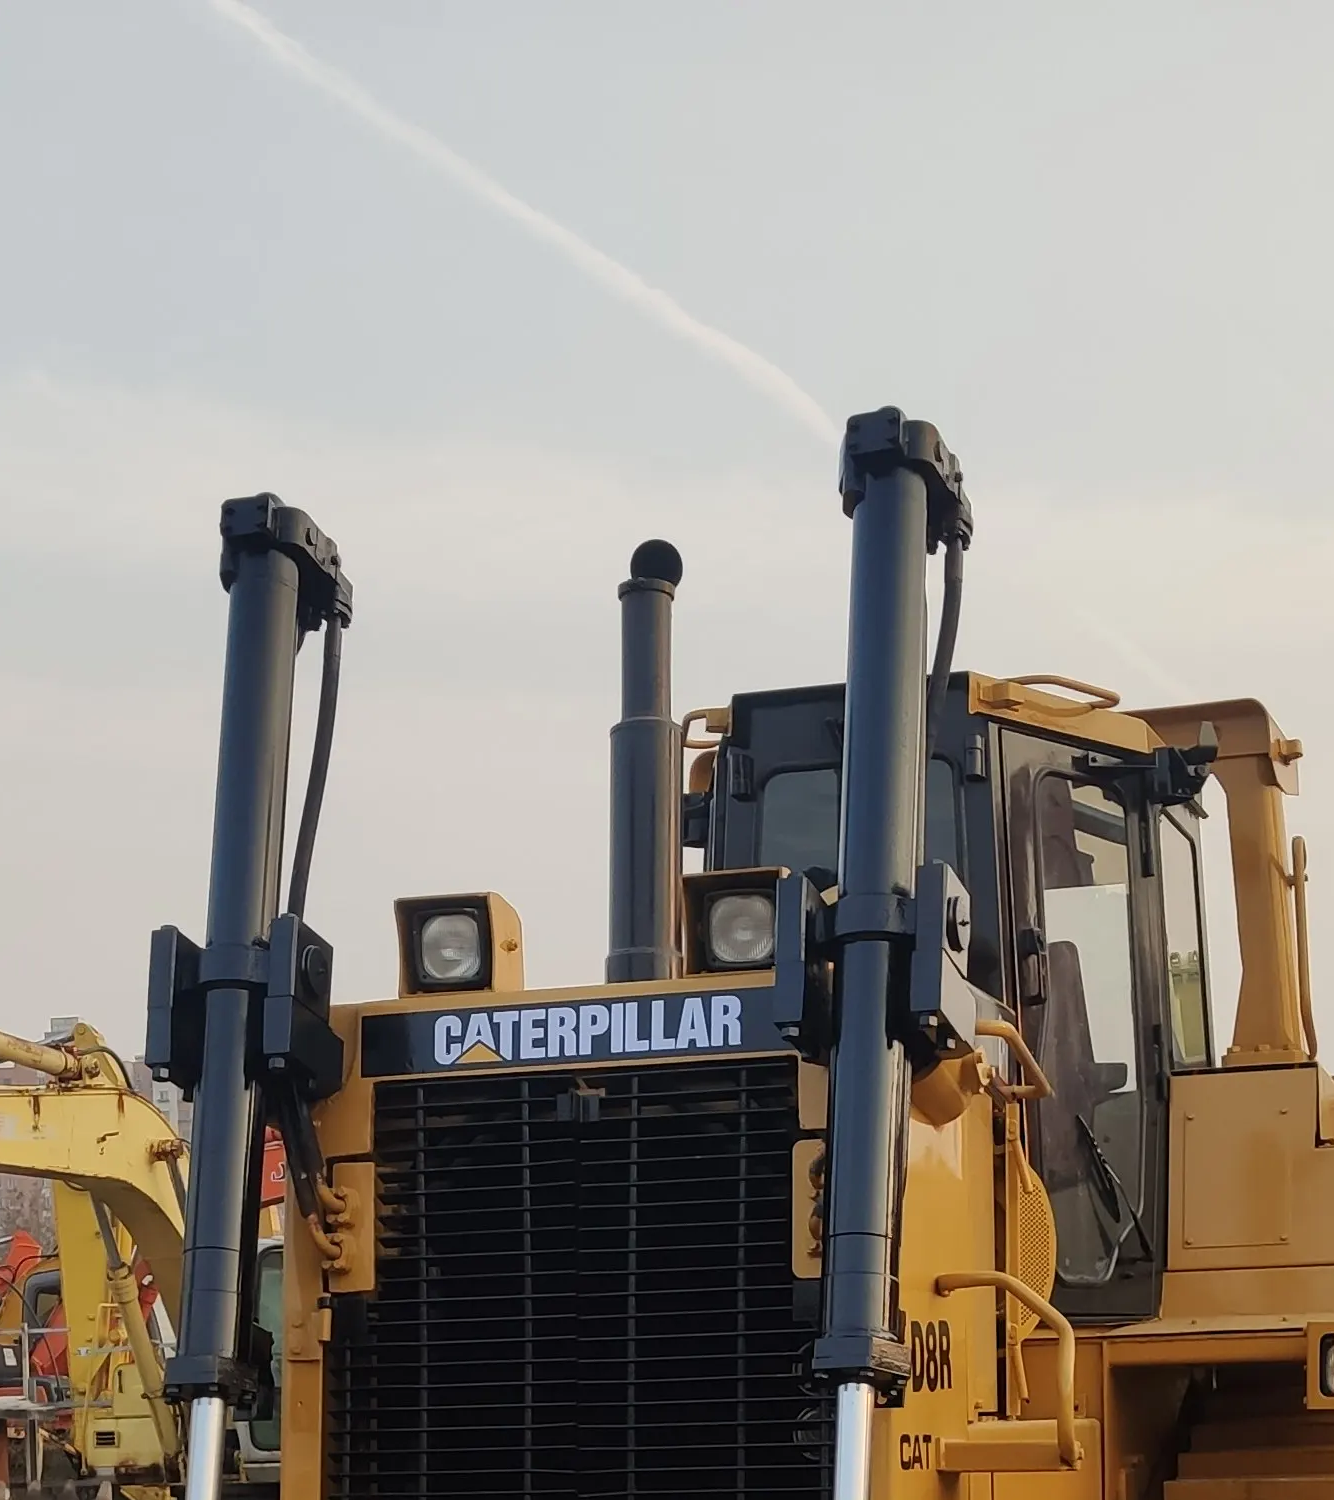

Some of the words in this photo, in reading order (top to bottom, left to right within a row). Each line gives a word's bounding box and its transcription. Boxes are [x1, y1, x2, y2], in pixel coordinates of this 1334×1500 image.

[434, 995, 742, 1065] CATERPILLAR
[910, 1319, 953, 1393] D8R
[899, 1433, 932, 1471] CAT
